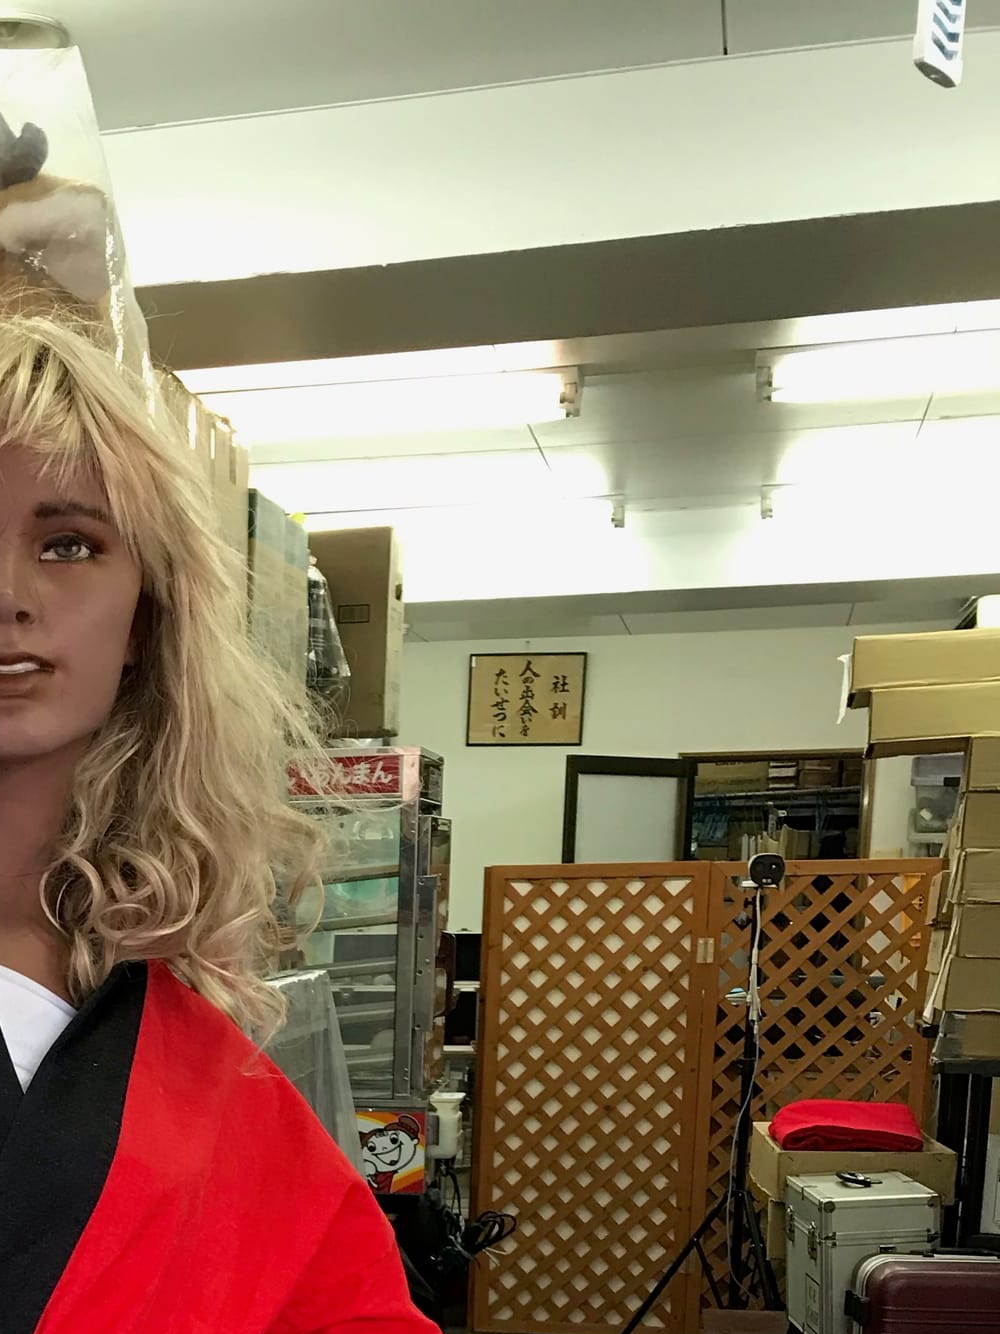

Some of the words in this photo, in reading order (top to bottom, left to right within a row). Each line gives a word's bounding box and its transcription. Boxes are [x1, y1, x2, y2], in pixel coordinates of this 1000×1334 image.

[490, 668, 510, 738] たいせつに
[518, 660, 541, 737] 人の出会いを
[549, 675, 570, 720] 社訓
